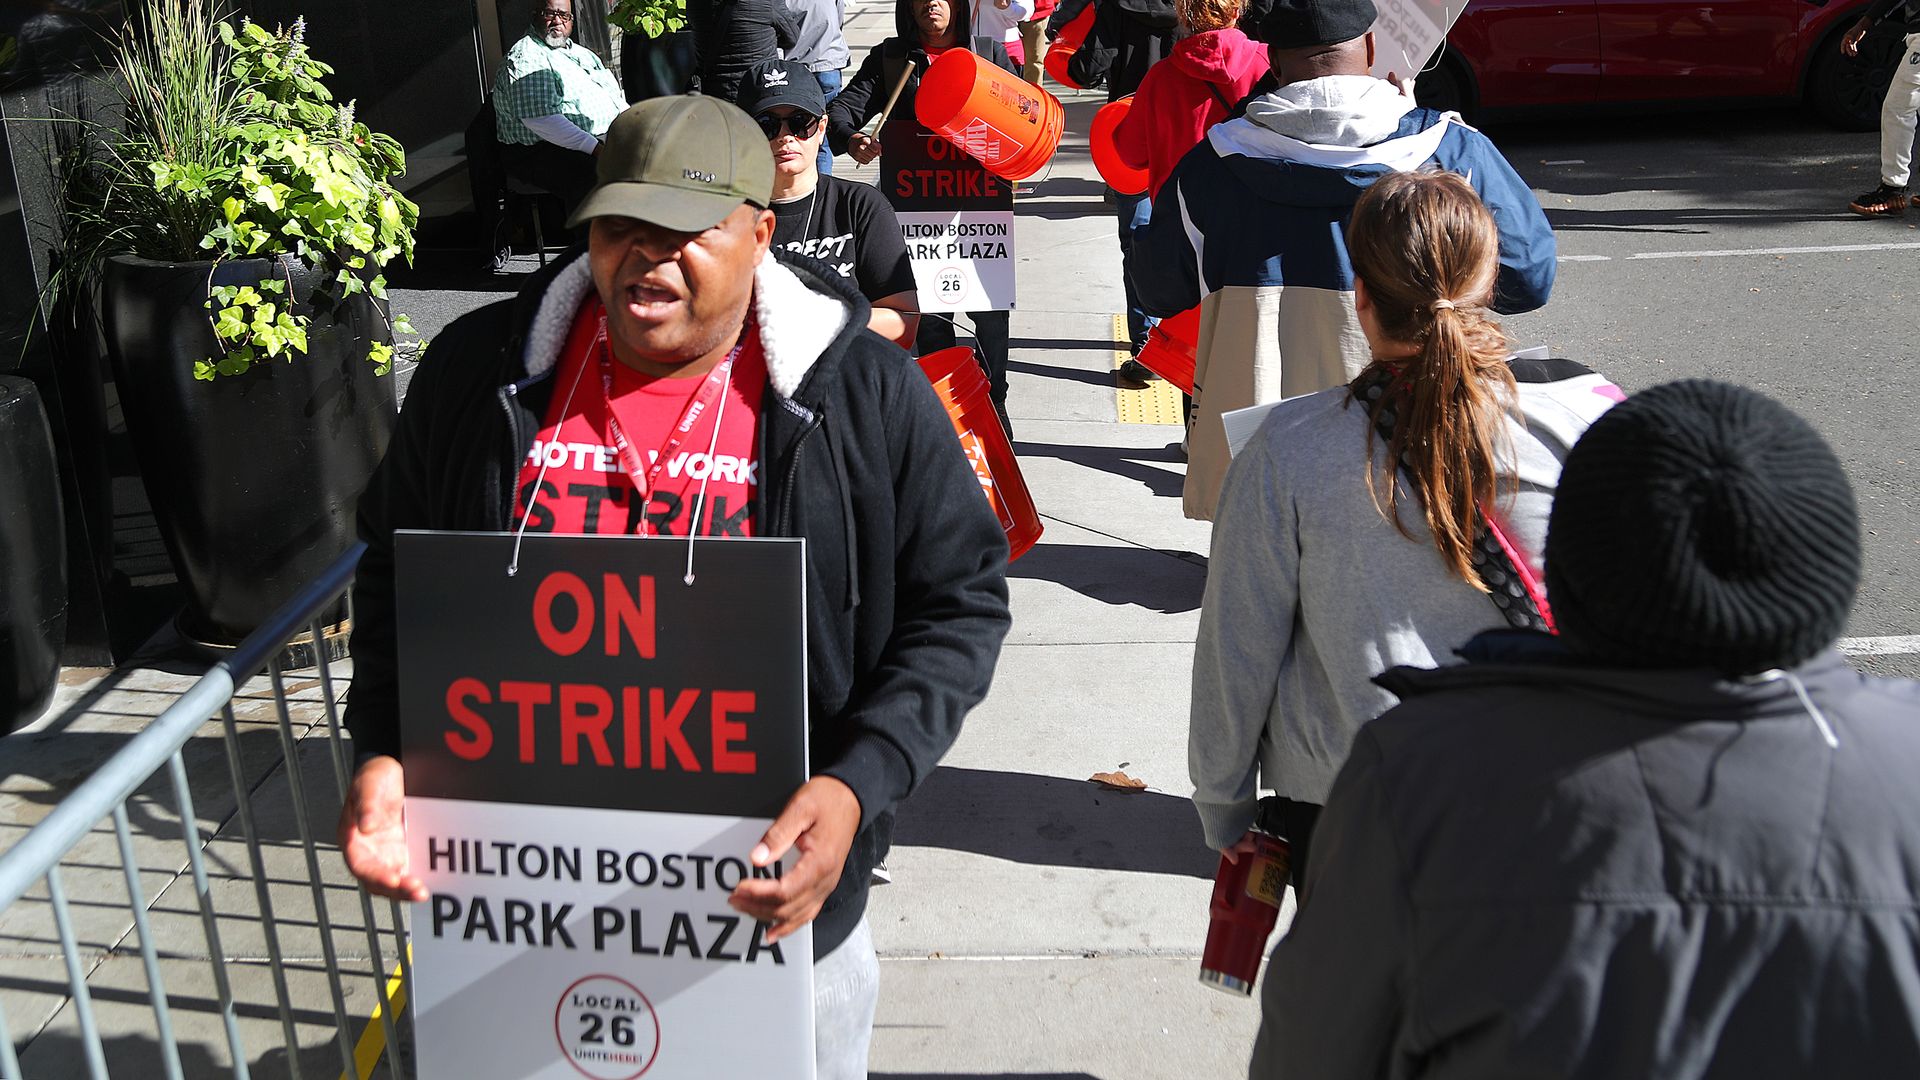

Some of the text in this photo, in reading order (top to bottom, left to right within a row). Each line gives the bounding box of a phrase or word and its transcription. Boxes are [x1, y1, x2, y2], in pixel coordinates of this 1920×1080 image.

[896, 169, 999, 198] STRIKE
[948, 223, 1007, 237] BOSTON
[777, 233, 853, 259] PECT
[947, 243, 1008, 260] PLAZA
[942, 280, 960, 291] 26
[679, 400, 705, 433] UNITE
[533, 571, 656, 659] ON
[444, 677, 757, 775] STRIKE
[429, 836, 582, 882] HILTON
[432, 893, 785, 966] PARK PLAZA
[573, 994, 641, 1012] LOCAL
[580, 1012, 635, 1047] 26
